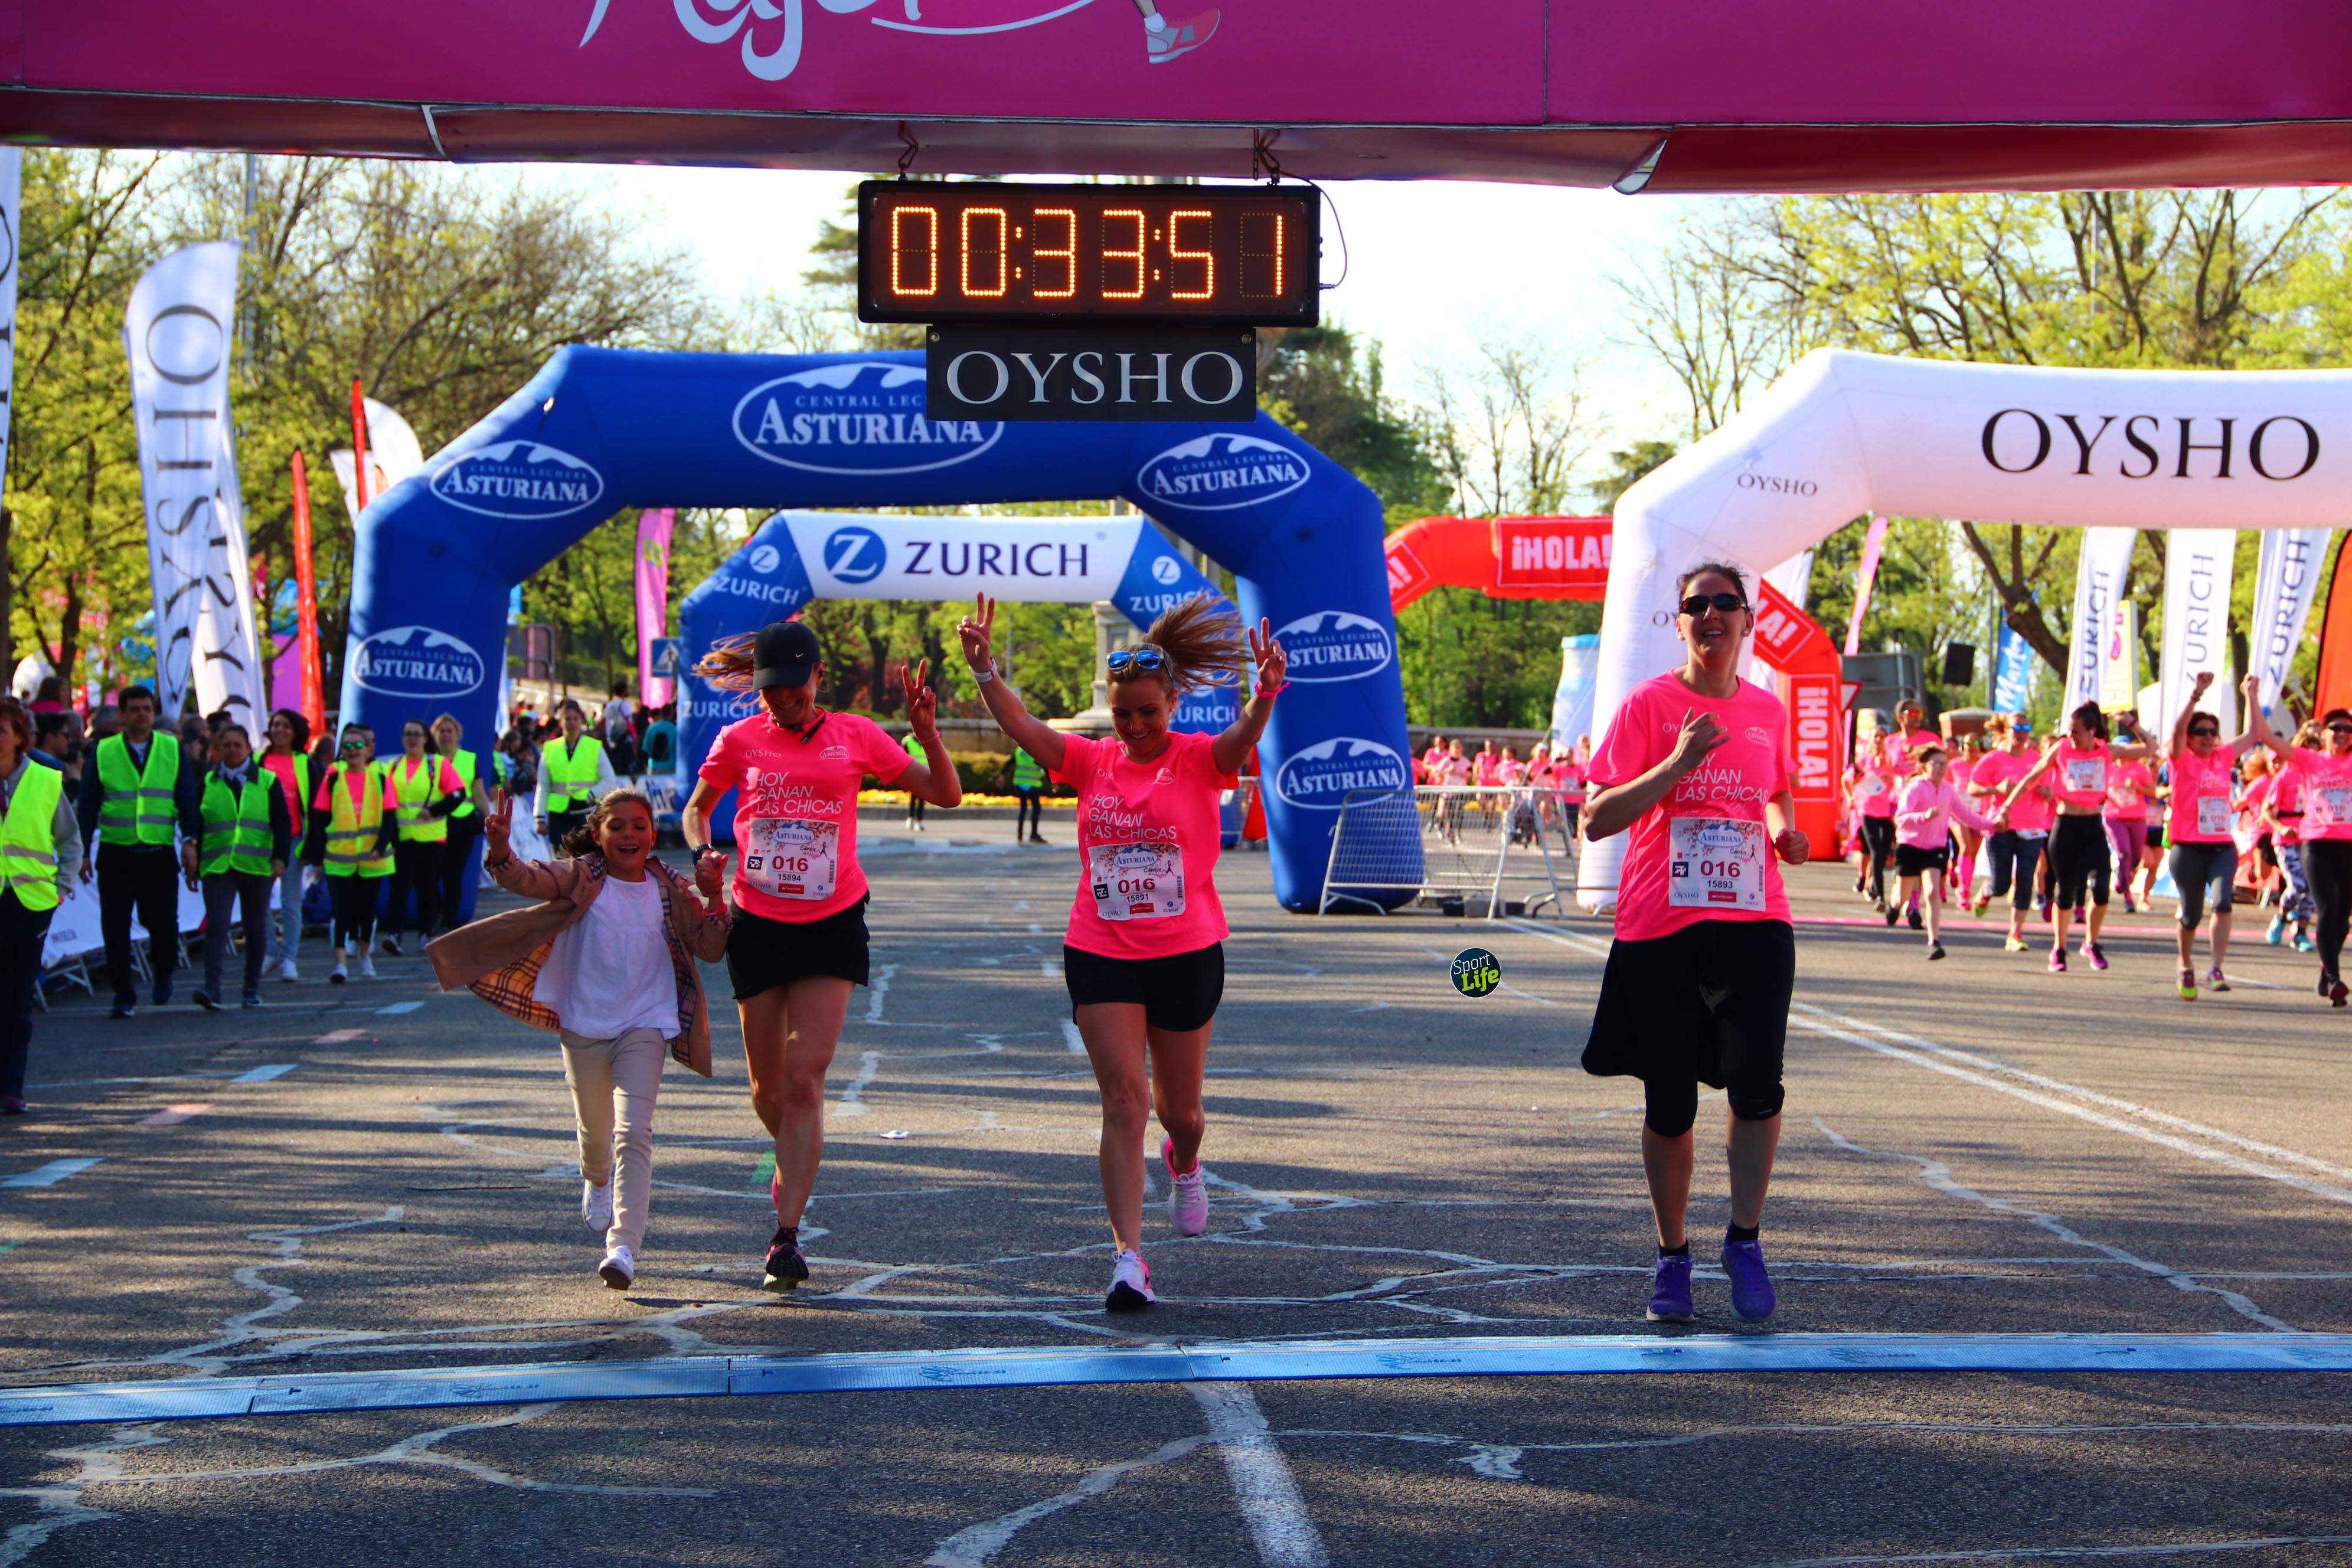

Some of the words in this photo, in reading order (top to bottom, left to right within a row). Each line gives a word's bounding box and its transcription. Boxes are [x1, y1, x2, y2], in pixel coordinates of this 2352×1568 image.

[946, 350, 1243, 405] OYSHO
[795, 395, 880, 408] CENTRAL
[753, 397, 985, 445] ASTURIANA
[1981, 409, 2320, 481] OYSHO
[1172, 459, 1229, 472] CENTRAL
[442, 466, 589, 502] ASTURIANA
[1153, 463, 1300, 495] ASTURIANA
[1737, 473, 1818, 496] OYSHO
[904, 541, 1089, 577] ZURICH
[715, 578, 799, 605] ZURICH
[1286, 642, 1386, 668] STURIANA
[357, 648, 475, 685] ASTURIANA
[682, 701, 755, 718] ZURICH
[1169, 705, 1236, 724] URICH
[745, 749, 782, 759] OYSHO
[756, 772, 789, 787] HOY
[1286, 767, 1400, 796] ASTURIANA
[756, 786, 814, 801] GANAN
[1091, 793, 1125, 811] HOY
[1675, 786, 1707, 802] LAS
[1710, 786, 1769, 805] CHICAS
[756, 801, 780, 814] LAS
[783, 799, 844, 814] CHICAS
[1089, 807, 1144, 827] GANAN
[775, 831, 812, 841] ASTURIANA
[1089, 822, 1112, 838] LAS
[1116, 825, 1177, 839] CHICAS
[1701, 832, 1741, 843] ASTURIANA
[772, 856, 809, 871] 016
[1116, 856, 1155, 864] ASTURIANA
[1700, 860, 1740, 877] 016
[778, 873, 801, 882] 15894
[1118, 878, 1156, 893] 016
[1707, 880, 1733, 888] 15893
[1127, 893, 1149, 903] 15891
